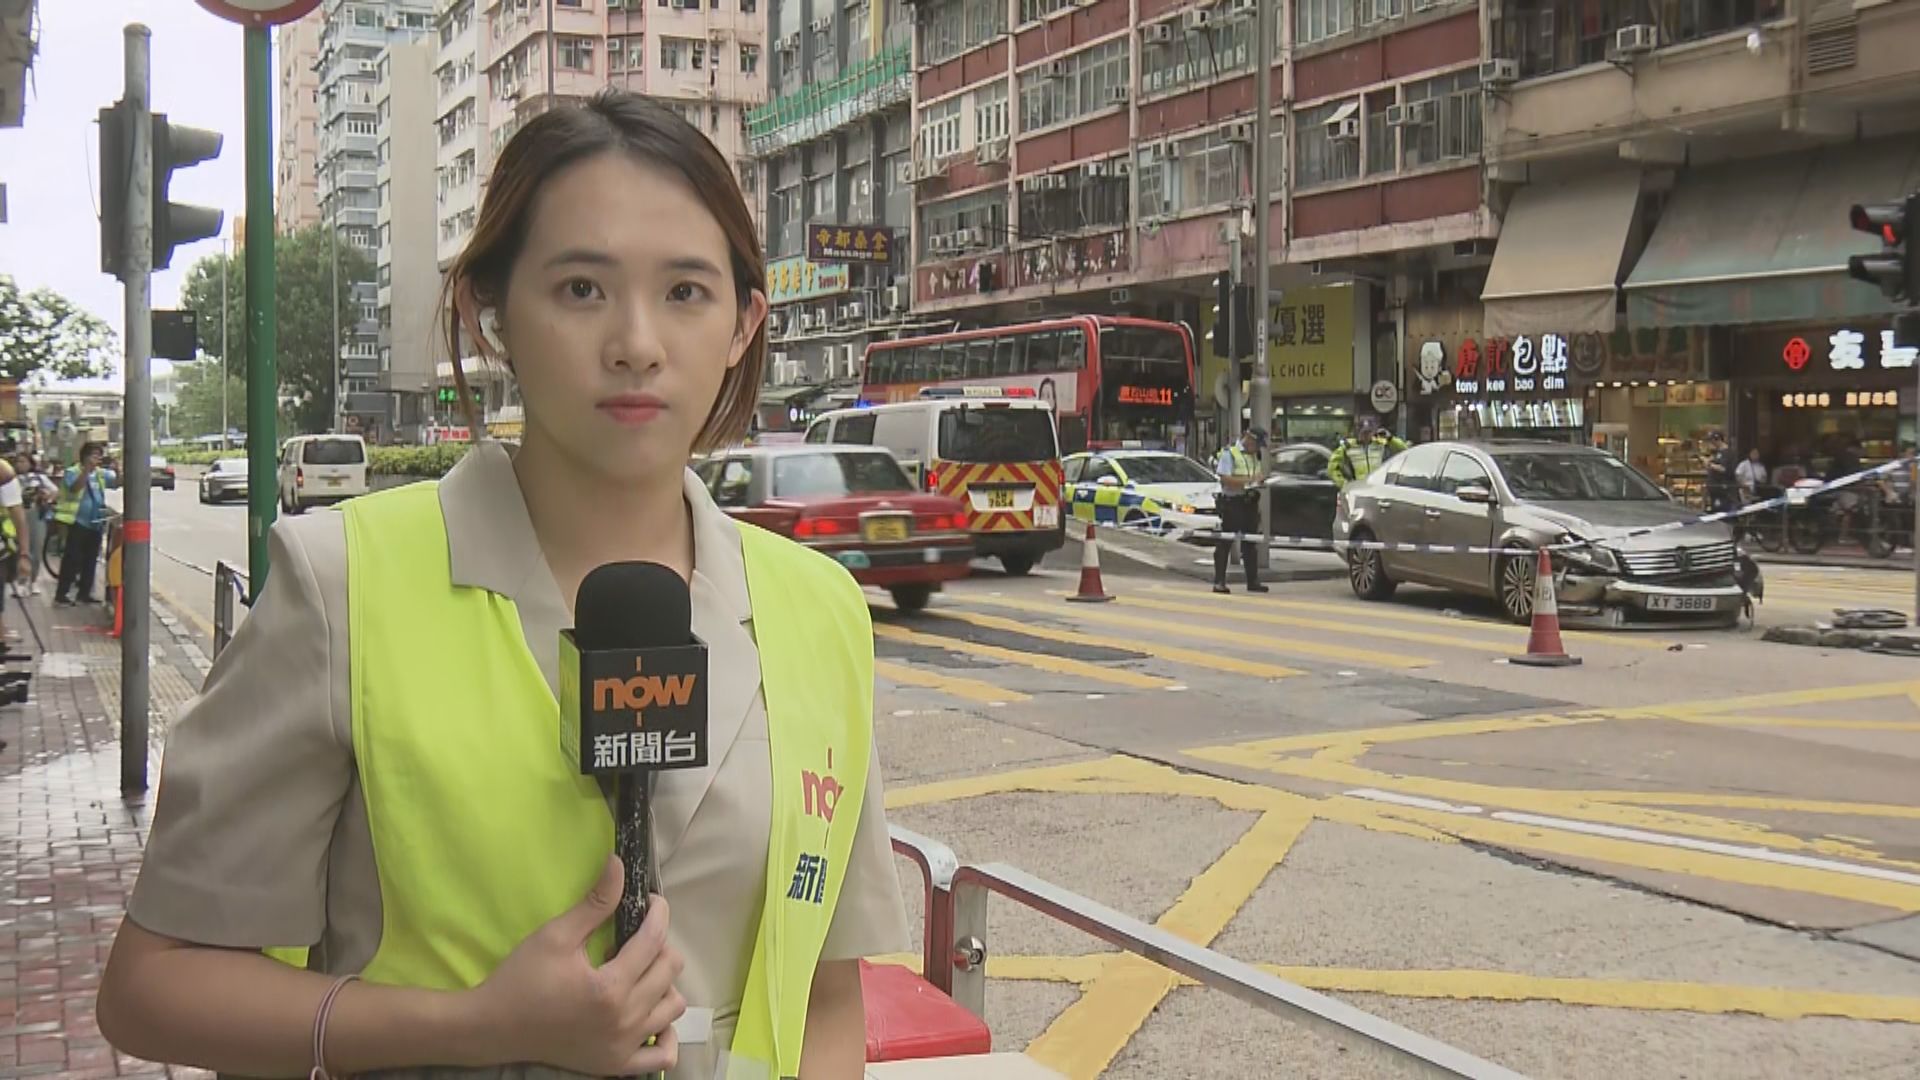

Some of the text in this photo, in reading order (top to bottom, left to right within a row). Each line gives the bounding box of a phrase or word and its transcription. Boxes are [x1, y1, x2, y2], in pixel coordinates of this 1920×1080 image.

[823, 247, 873, 259] Massage
[1280, 363, 1326, 378] CHOICE
[1456, 376, 1564, 393] tong kee bao dim
[1160, 386, 1172, 405] 11
[593, 674, 696, 711] now
[593, 730, 696, 768] 新聞台
[802, 770, 844, 823] no
